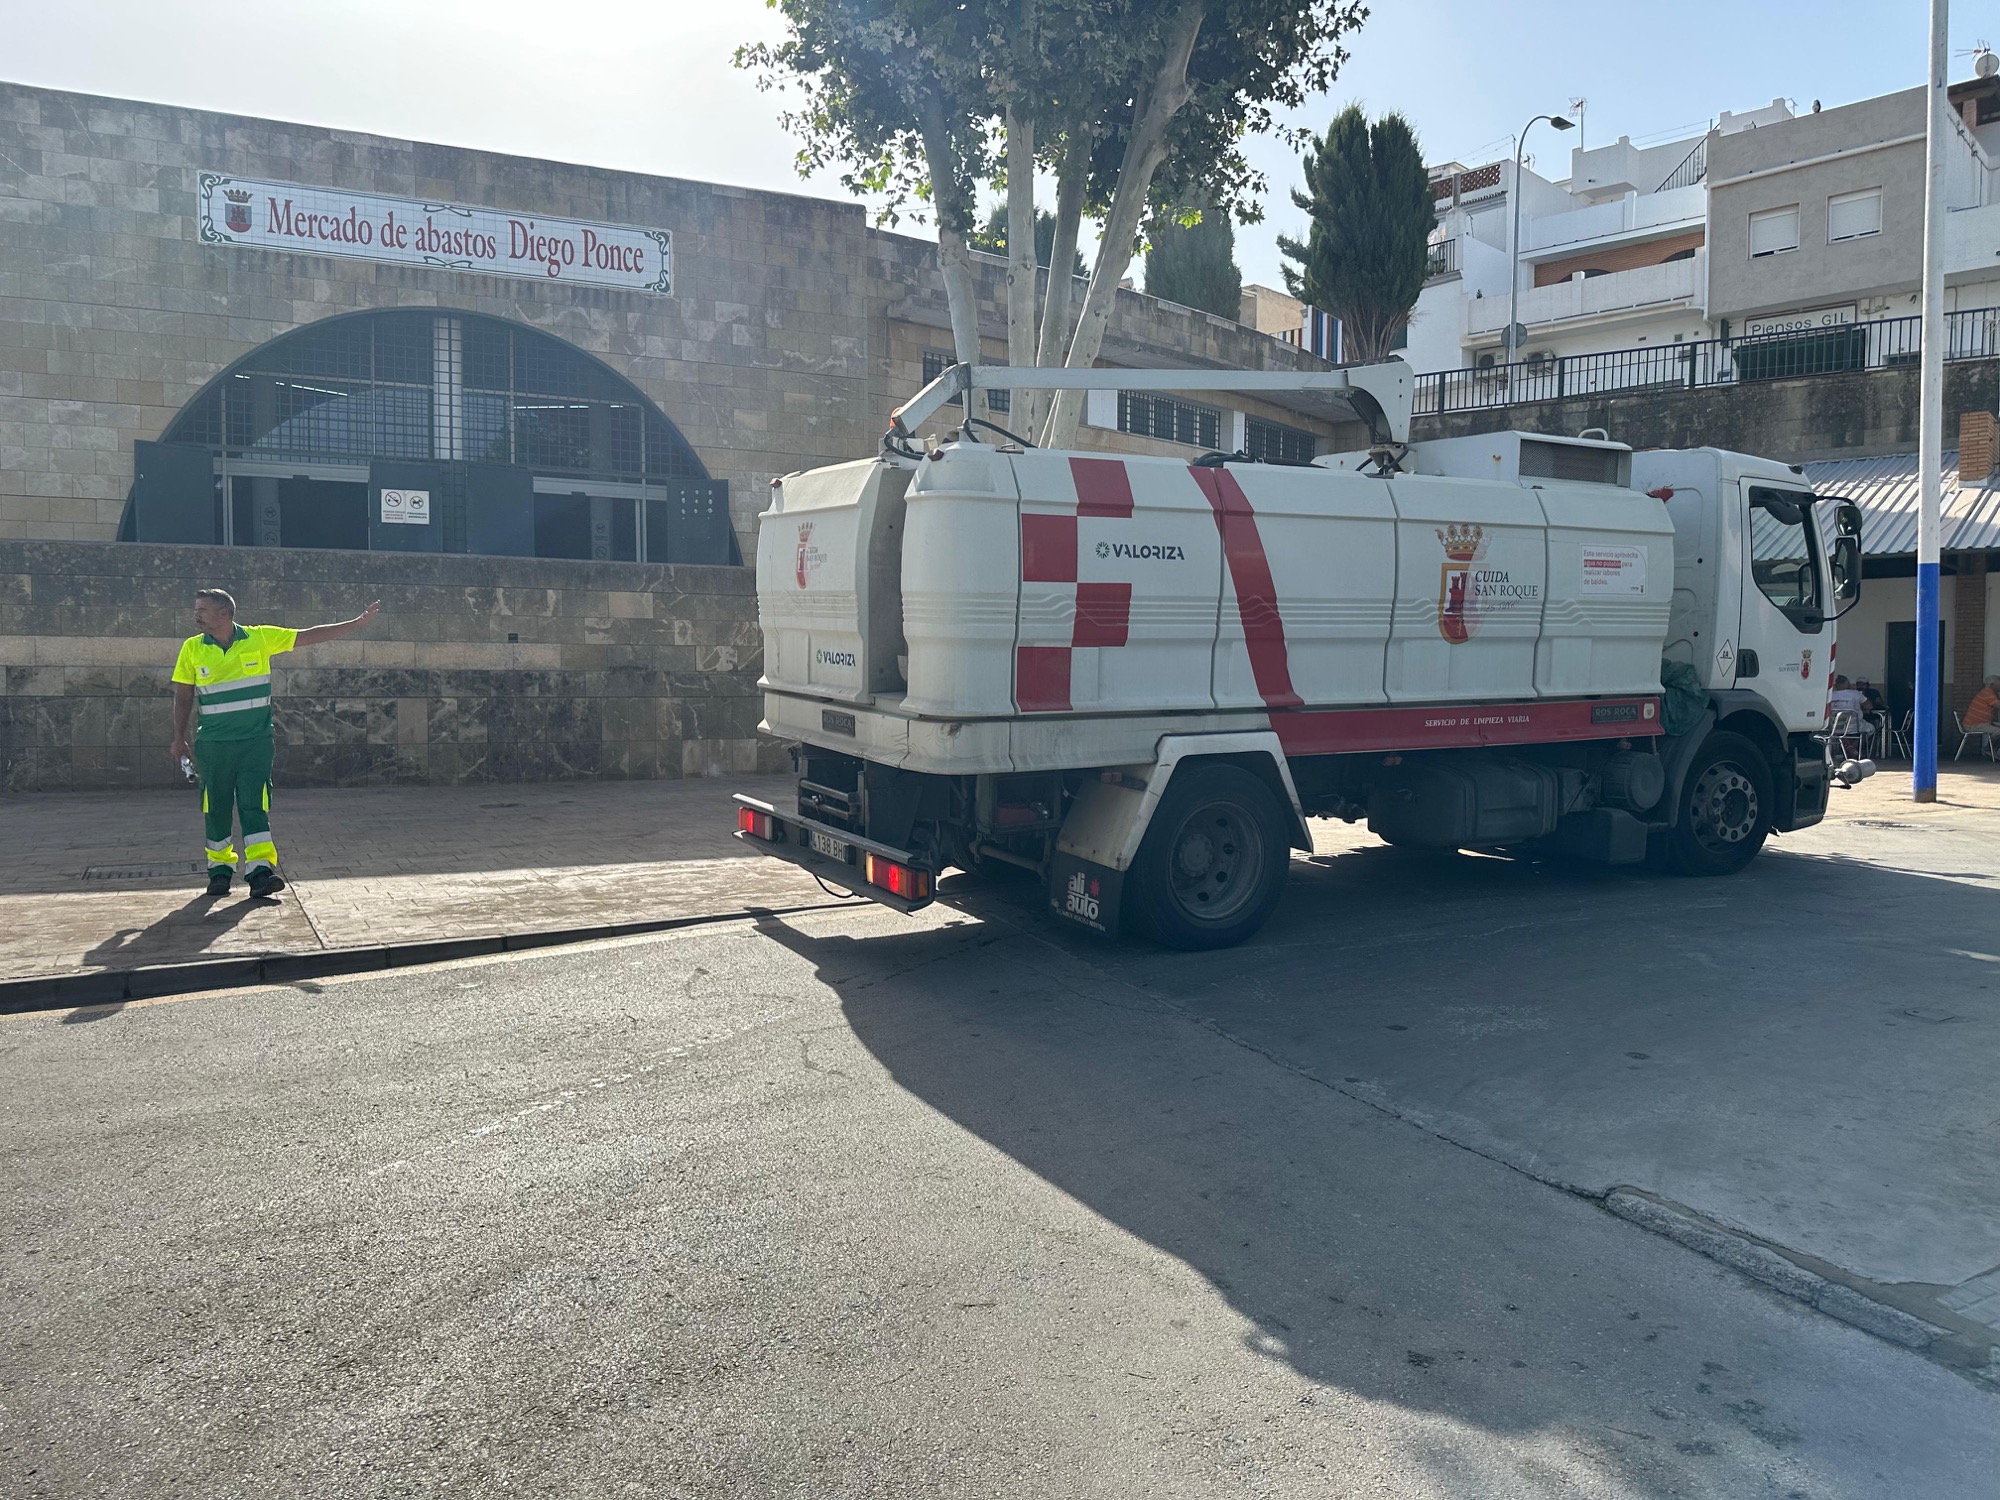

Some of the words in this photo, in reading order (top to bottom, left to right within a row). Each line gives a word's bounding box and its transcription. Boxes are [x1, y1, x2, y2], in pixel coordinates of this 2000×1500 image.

[267, 197, 373, 245] Mercado
[380, 211, 408, 249] de
[415, 216, 496, 259] abastos
[508, 220, 574, 278] Diego
[581, 228, 644, 273] Ponce
[1752, 319, 1812, 335] Piensos
[1821, 312, 1849, 326] GIL
[1112, 543, 1185, 560] VALORIZA
[1475, 570, 1510, 583] CUIDA
[1475, 584, 1497, 596] SAN
[1500, 584, 1538, 599] ROQUE
[823, 651, 856, 667] VALORIZA
[1595, 707, 1611, 717] ROS
[1615, 706, 1637, 716] ROCA
[1425, 719, 1456, 727] SERVICIO
[1460, 718, 1470, 726] DE
[1474, 716, 1504, 725] LIMPIEZA
[1508, 715, 1530, 723] VIARIA
[1068, 872, 1085, 895] ali
[1066, 893, 1099, 920] auto
